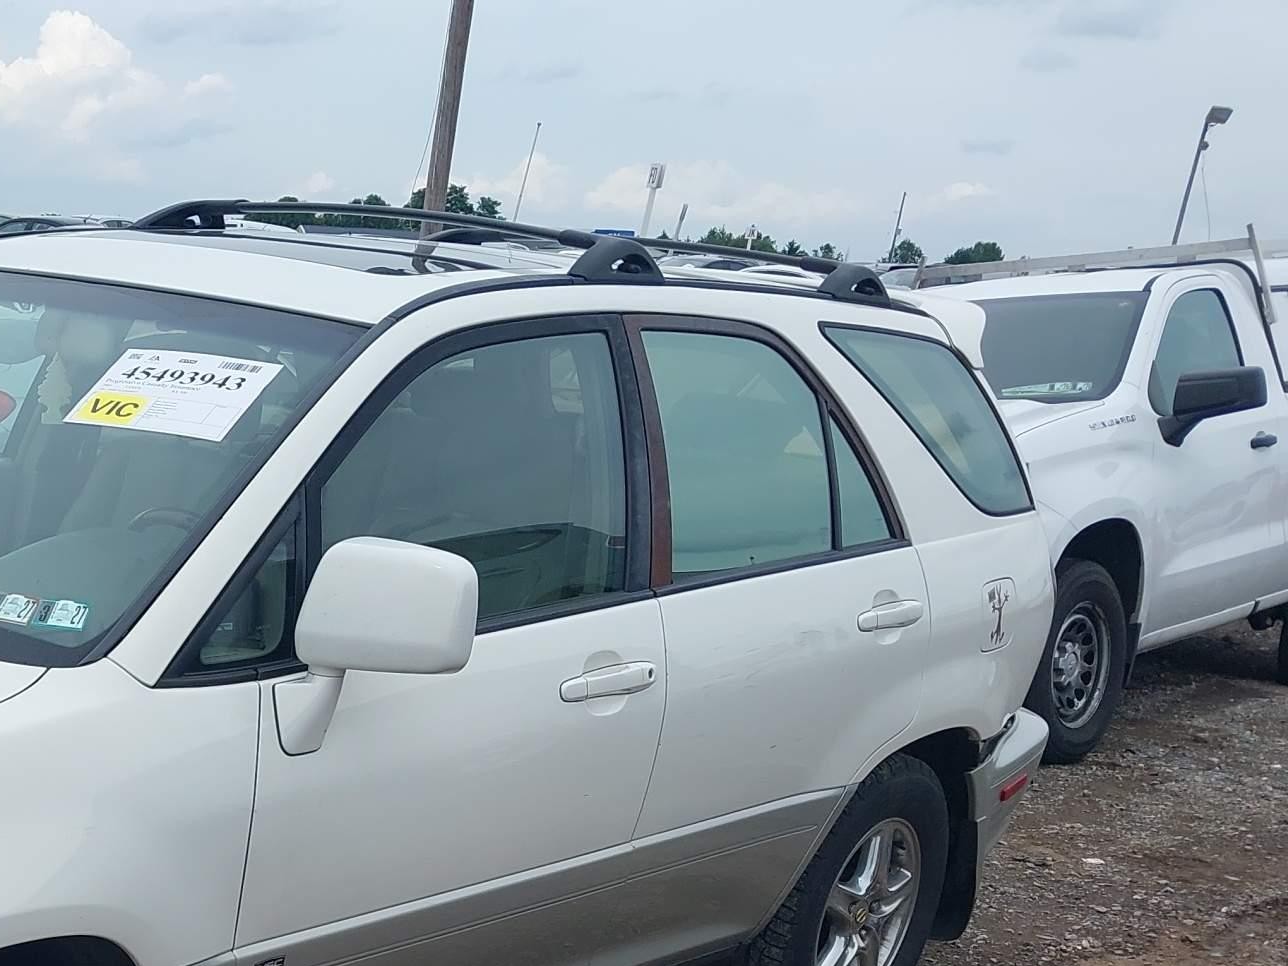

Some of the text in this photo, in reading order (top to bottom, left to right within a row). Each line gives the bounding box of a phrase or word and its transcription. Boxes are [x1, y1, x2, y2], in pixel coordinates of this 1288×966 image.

[121, 365, 247, 391] 45493943
[90, 398, 140, 418] VIC
[17, 600, 37, 619] 27
[38, 605, 88, 624] 3 27
